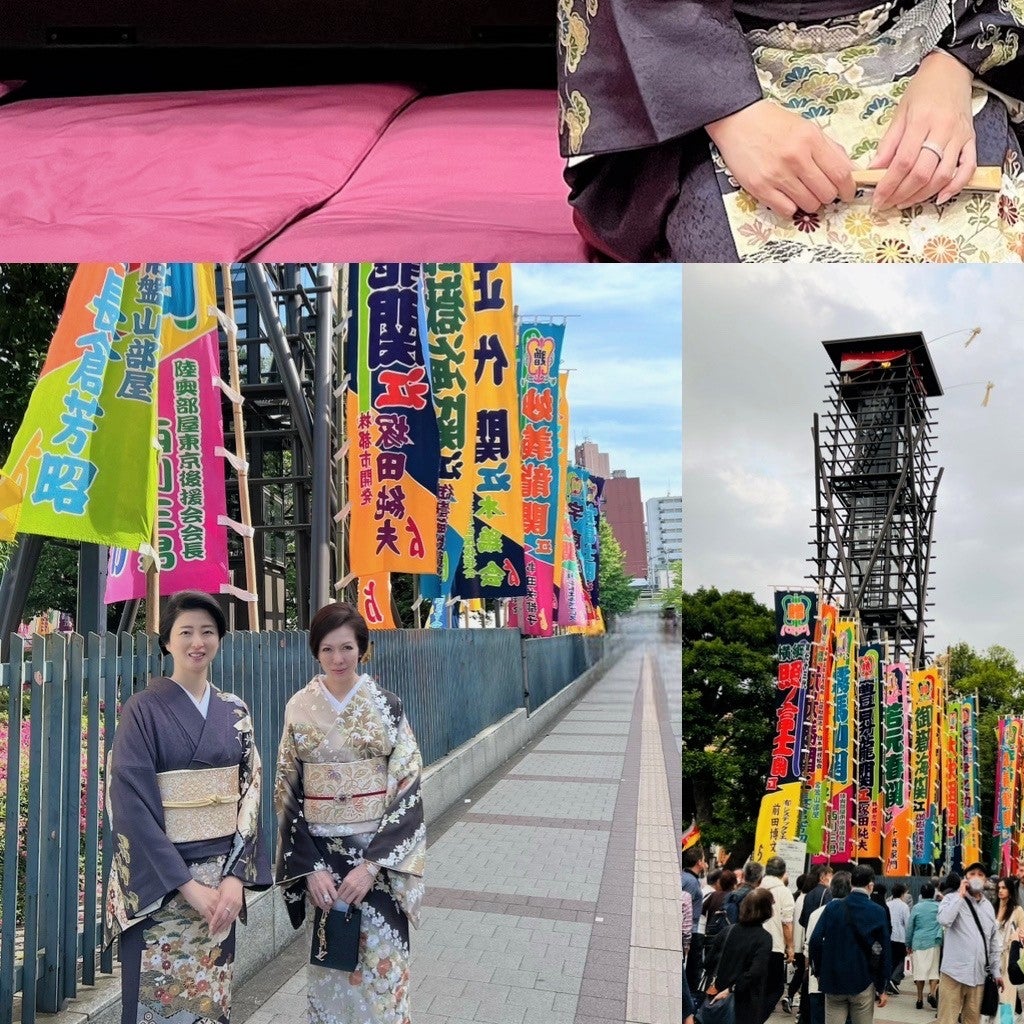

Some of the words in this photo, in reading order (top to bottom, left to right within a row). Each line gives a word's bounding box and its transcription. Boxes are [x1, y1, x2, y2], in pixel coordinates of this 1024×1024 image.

[30, 267, 127, 516] 長倉芳昭
[171, 358, 206, 562] 陸奥部屋東京後援会会長
